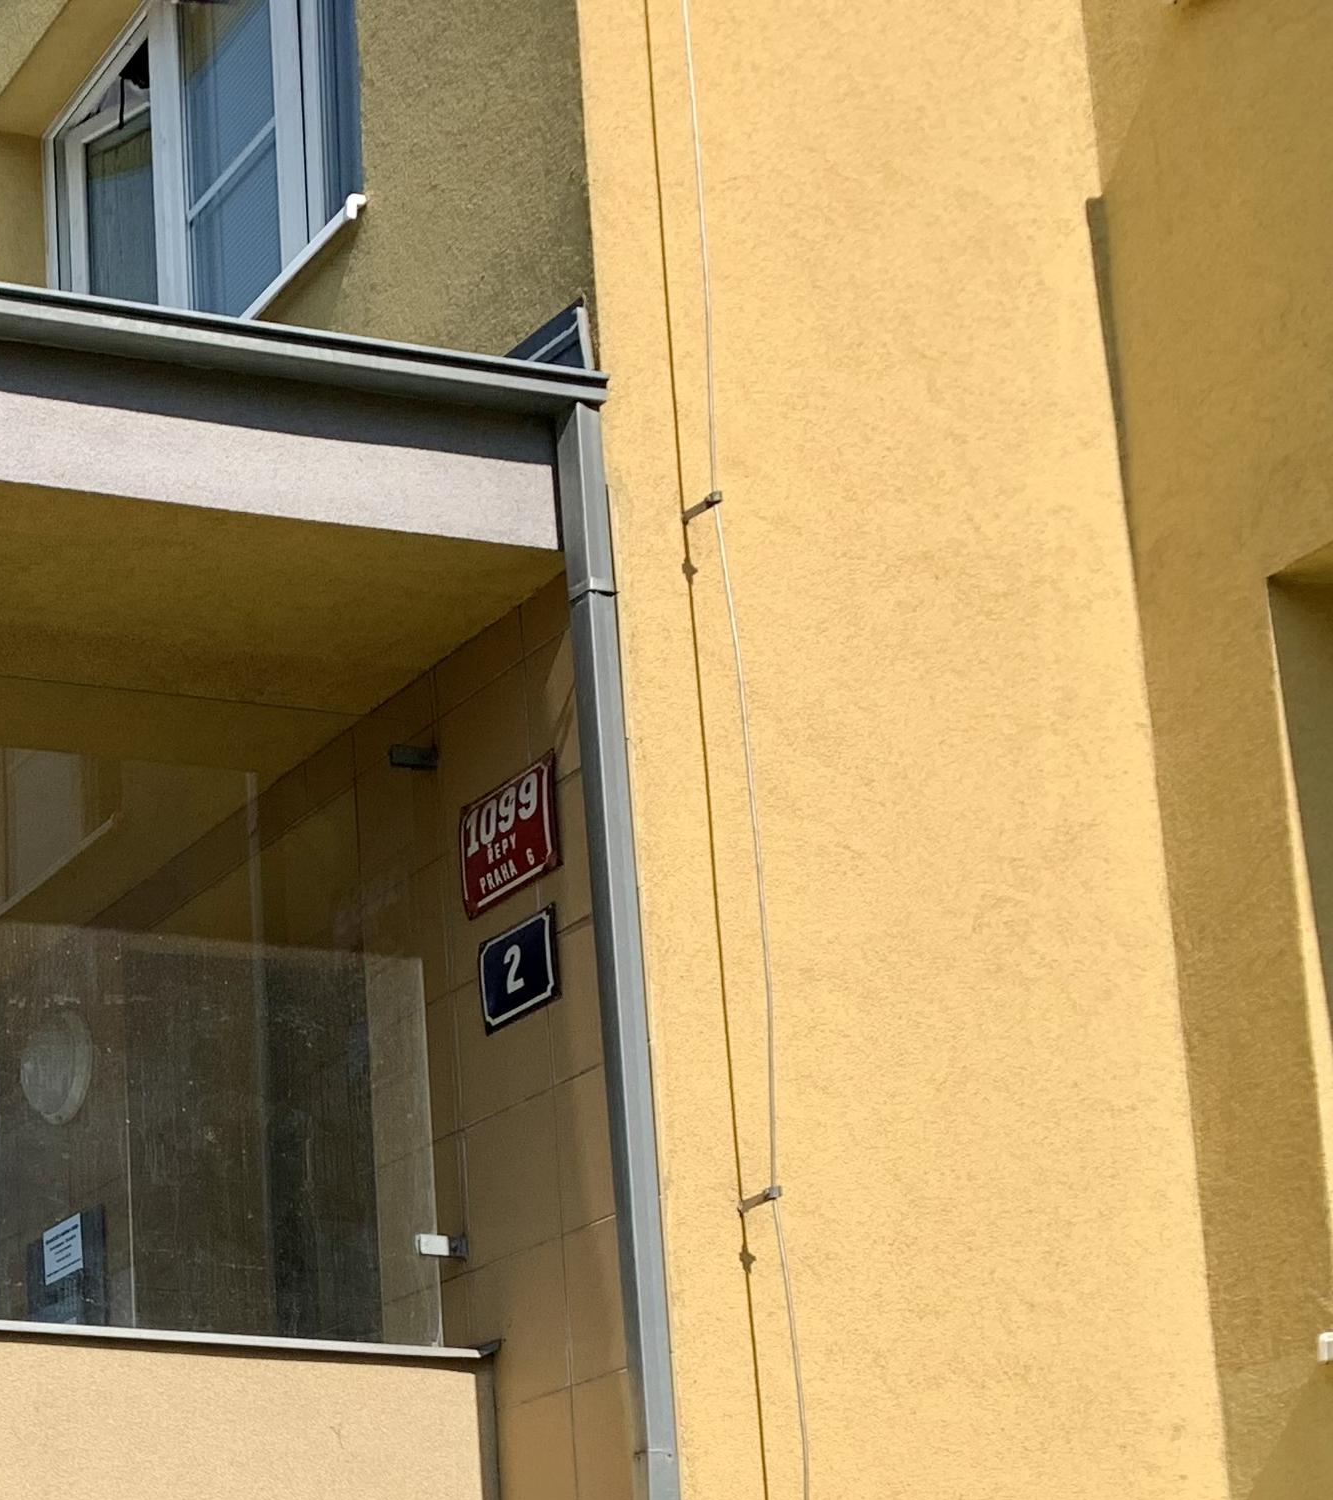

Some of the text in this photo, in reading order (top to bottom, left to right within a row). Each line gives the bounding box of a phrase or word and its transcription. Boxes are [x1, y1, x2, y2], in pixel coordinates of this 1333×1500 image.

[465, 772, 538, 858] 1099
[479, 848, 536, 894] PRAHA 6
[486, 832, 517, 865] ŘEPY
[503, 944, 525, 994] 2
